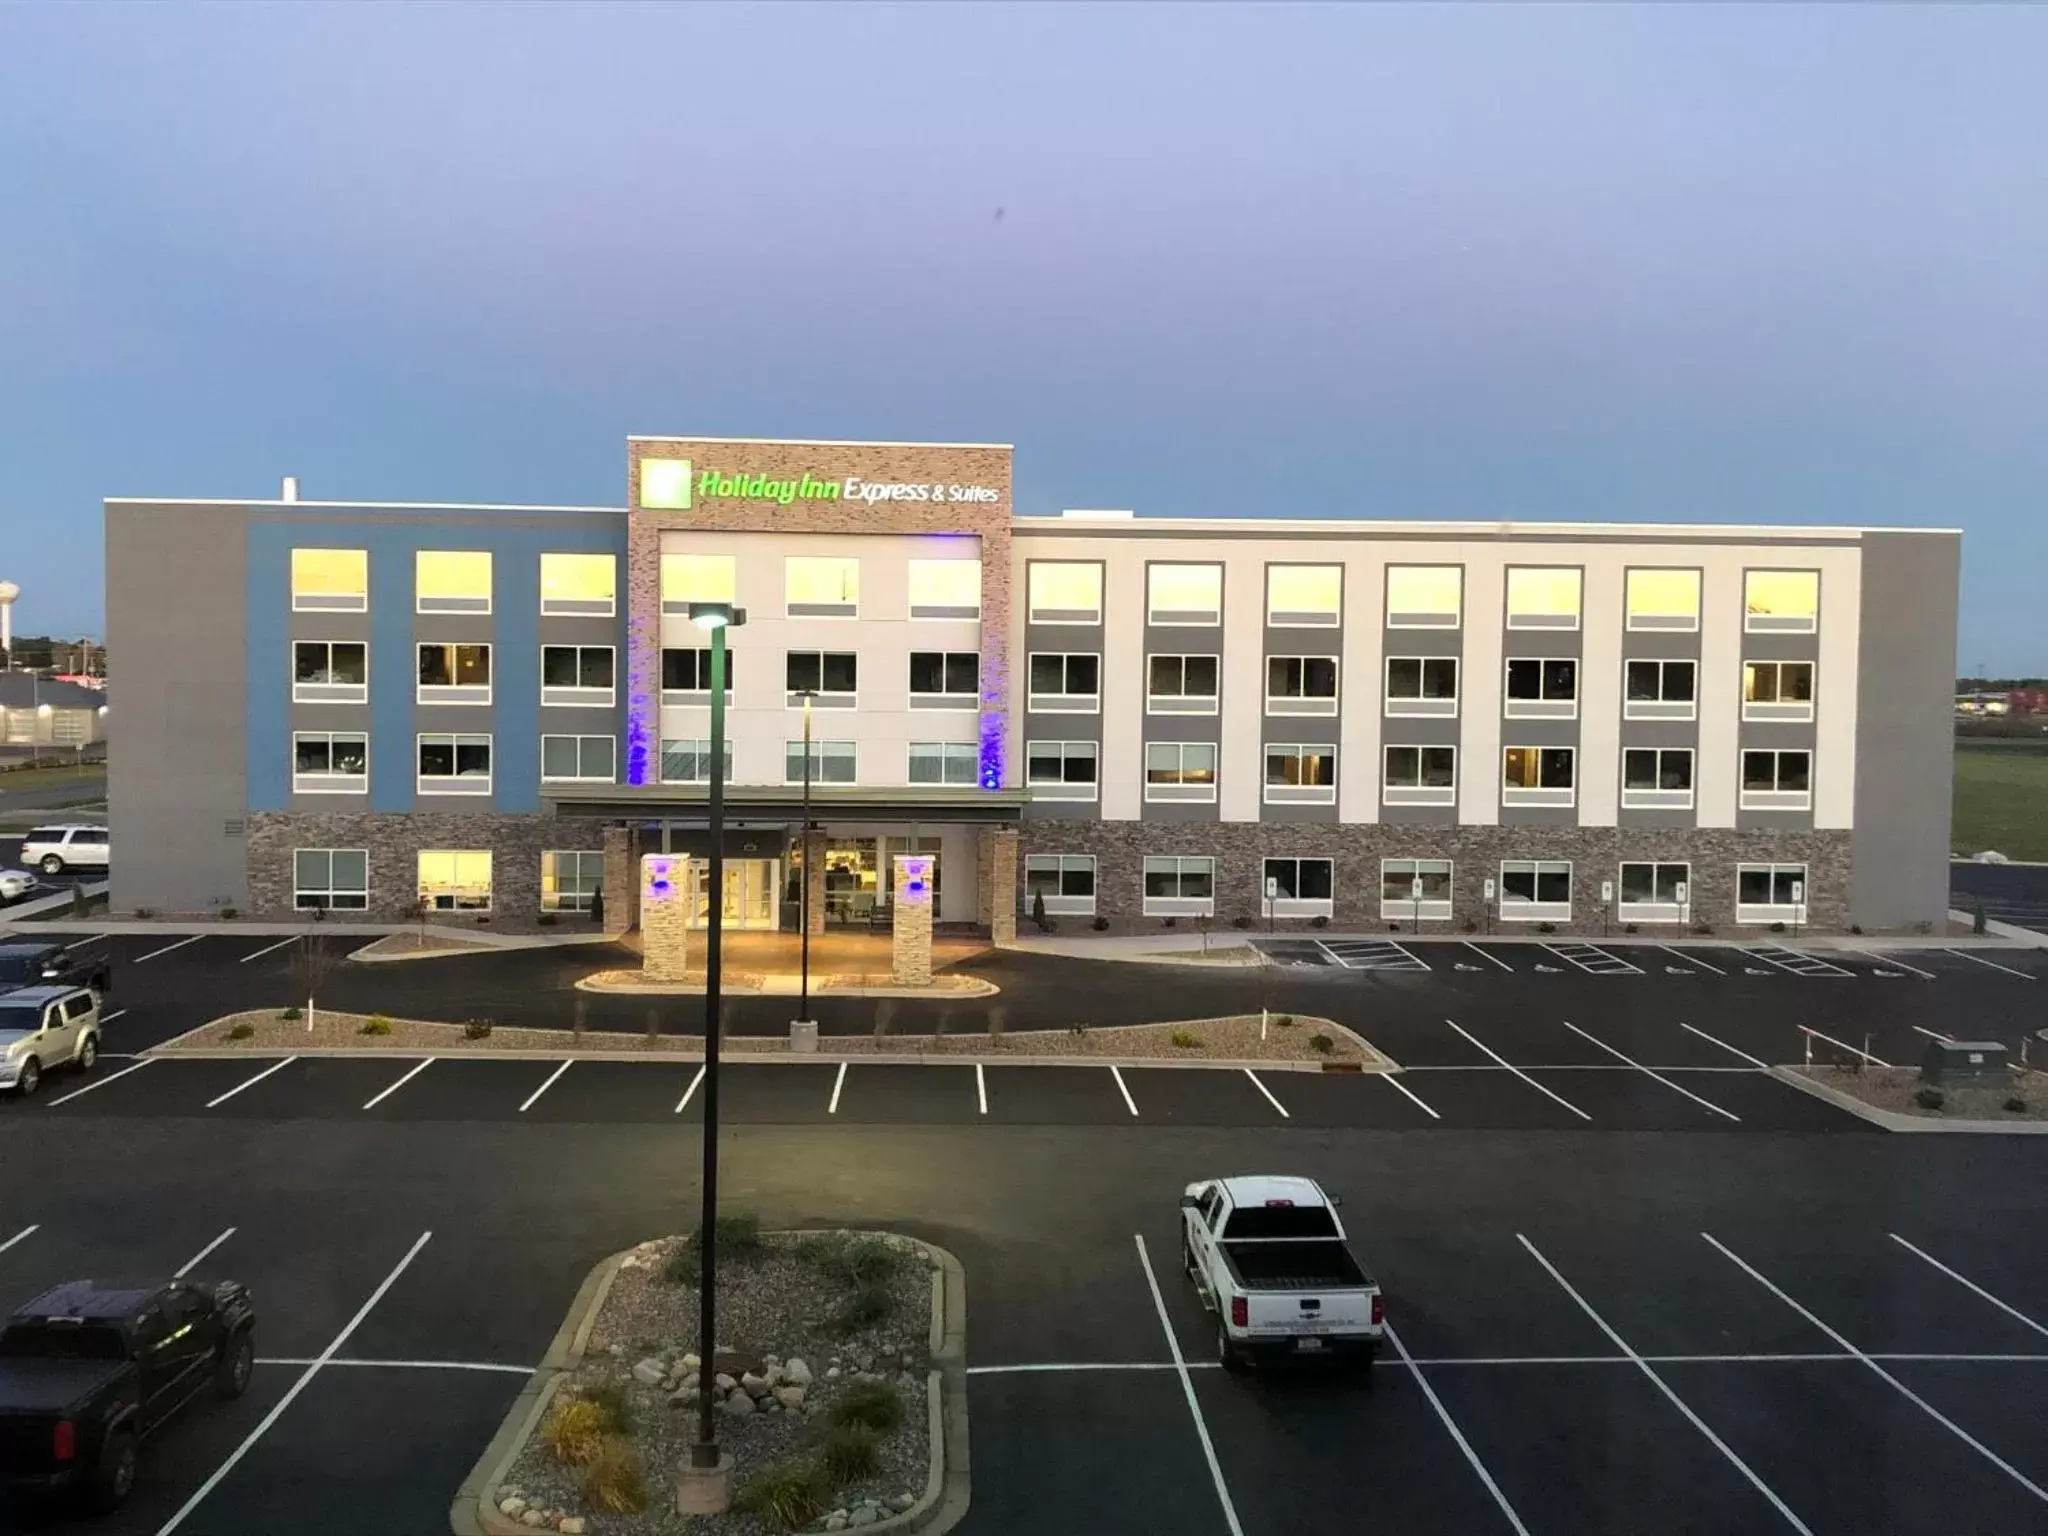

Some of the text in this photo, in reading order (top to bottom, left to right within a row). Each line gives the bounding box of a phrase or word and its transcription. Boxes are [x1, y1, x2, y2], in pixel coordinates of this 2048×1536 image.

[698, 470, 1000, 506] Holiday Inn Express & Suites
